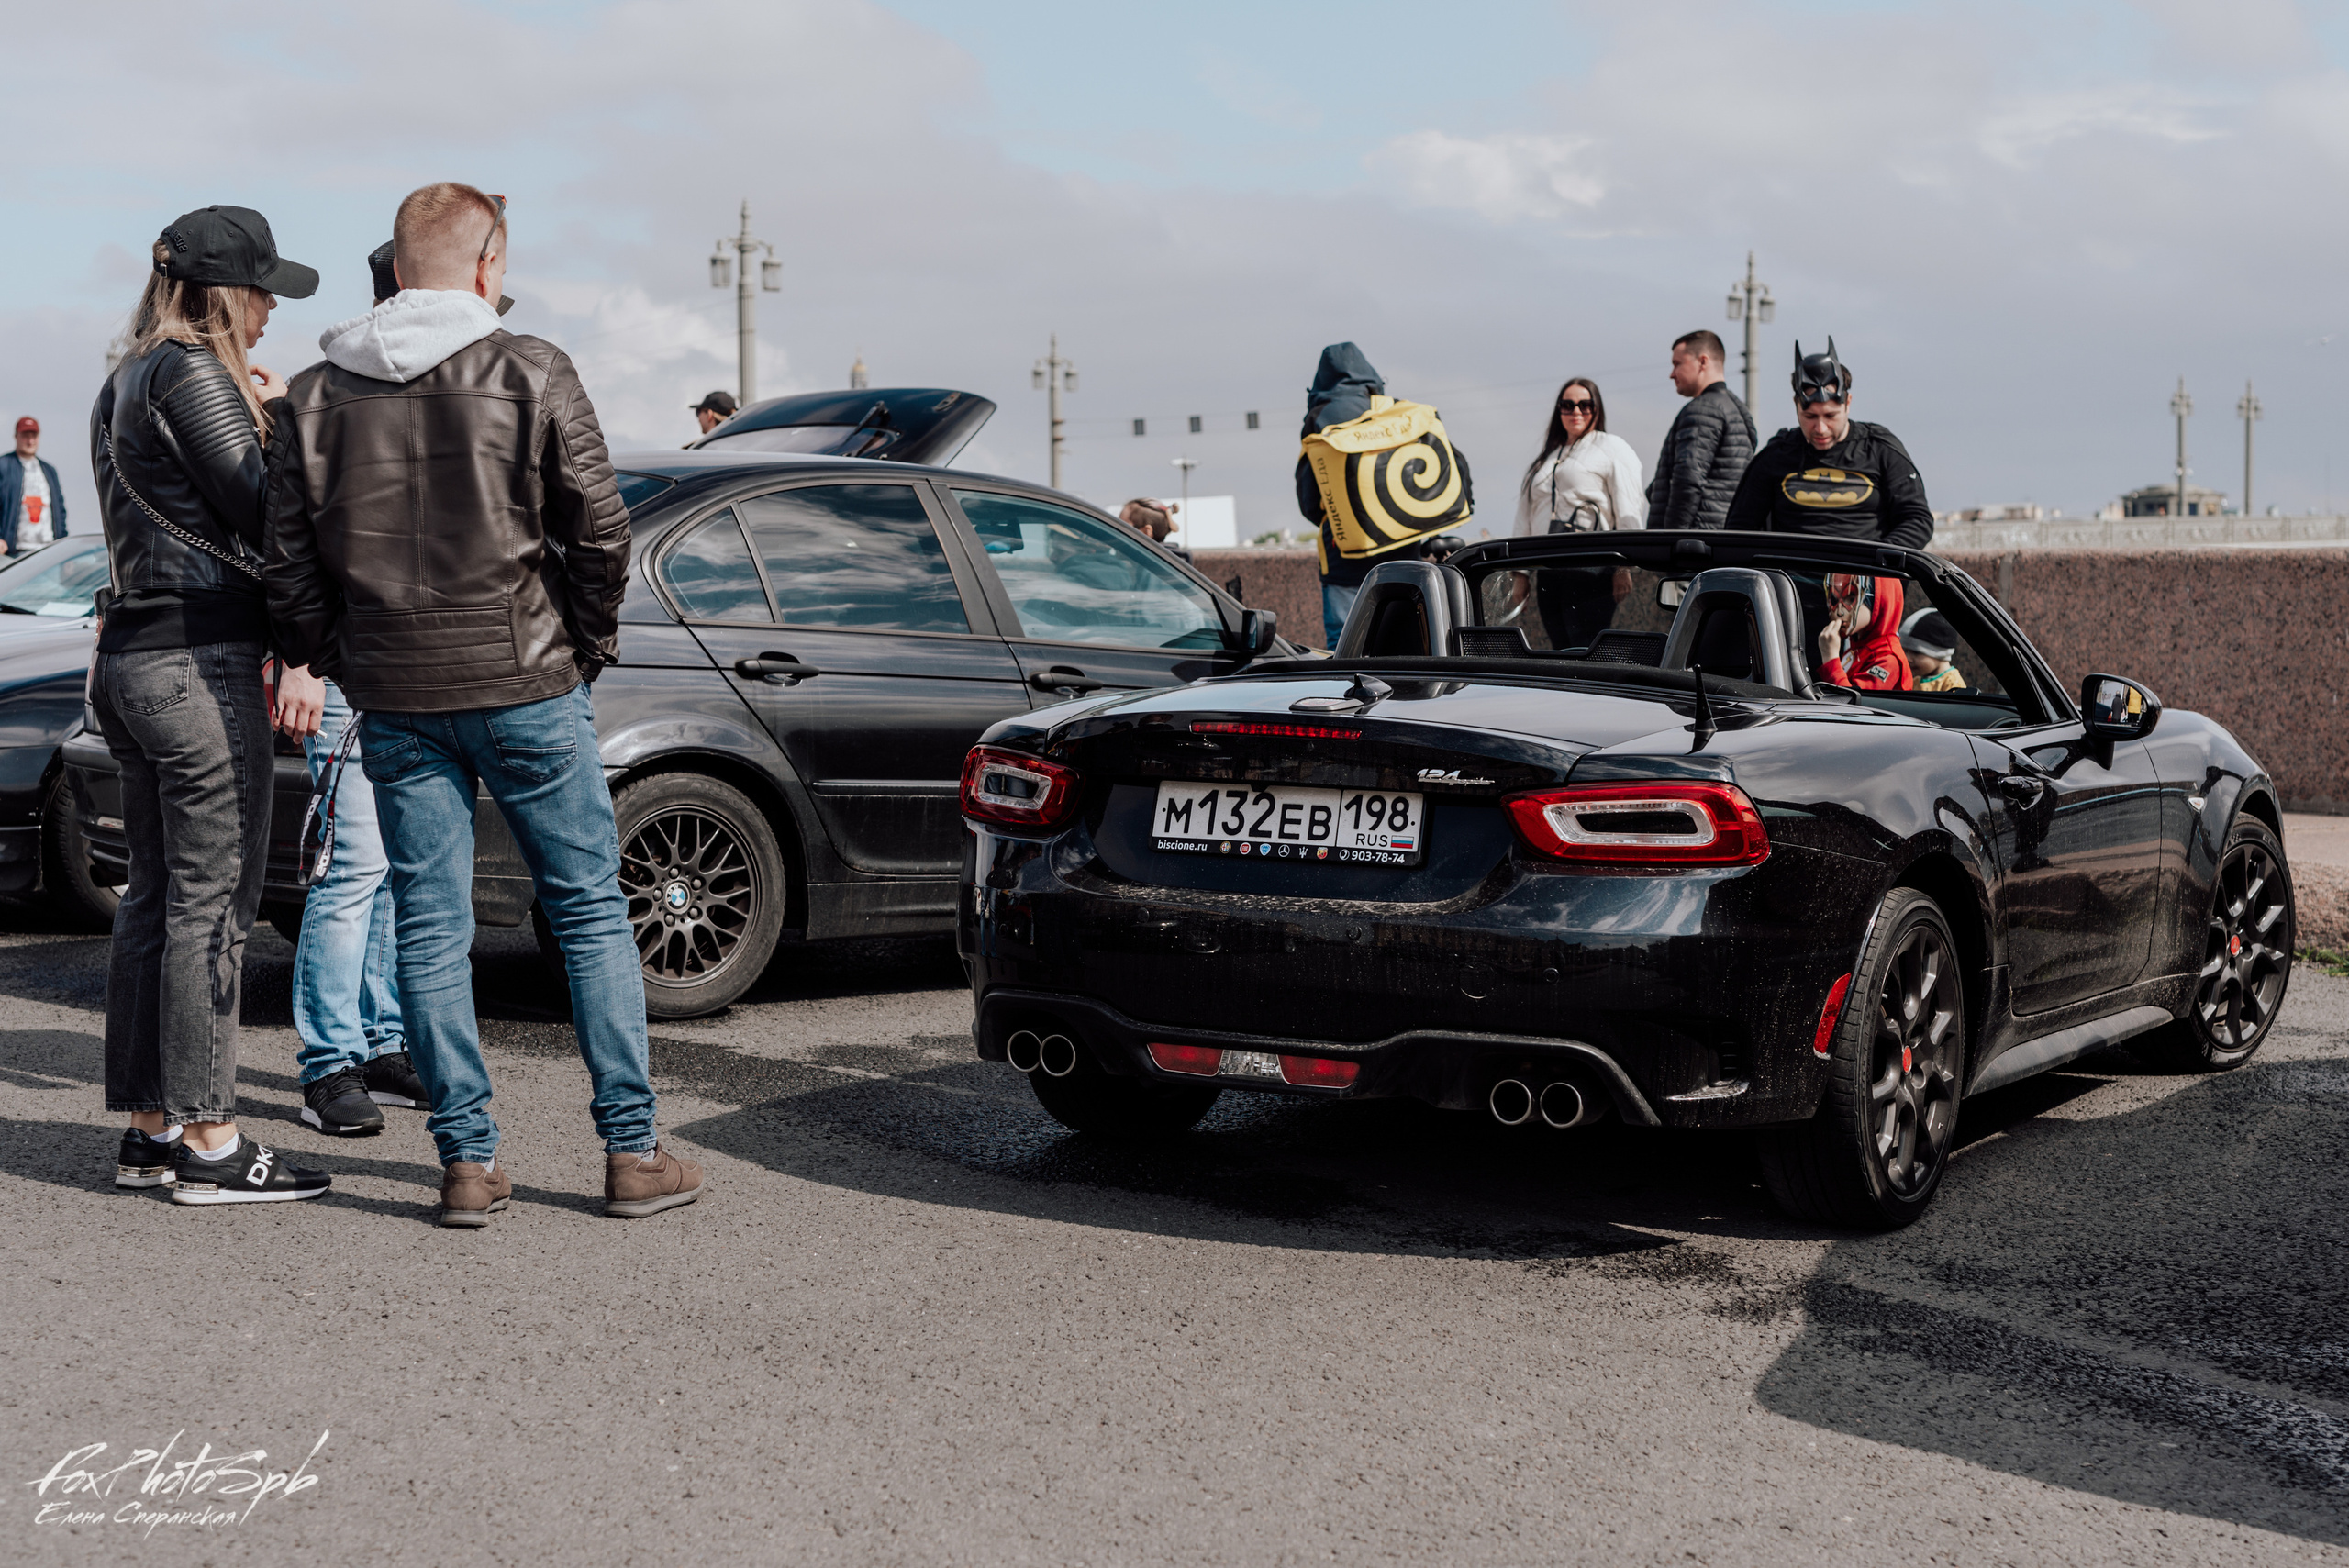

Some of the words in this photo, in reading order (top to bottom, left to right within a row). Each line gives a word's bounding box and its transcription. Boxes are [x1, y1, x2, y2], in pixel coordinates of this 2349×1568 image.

[1353, 427, 1393, 441] Яндекс
[1317, 457, 1330, 485] Еда
[1325, 488, 1347, 541] Яндекс
[1417, 768, 1461, 786] 124
[1163, 789, 1332, 840] М132ЕВ
[1343, 794, 1410, 832] 198
[1157, 839, 1208, 852] biscione.ru
[1355, 832, 1389, 848] RUS
[1351, 851, 1406, 864] 903-78-74
